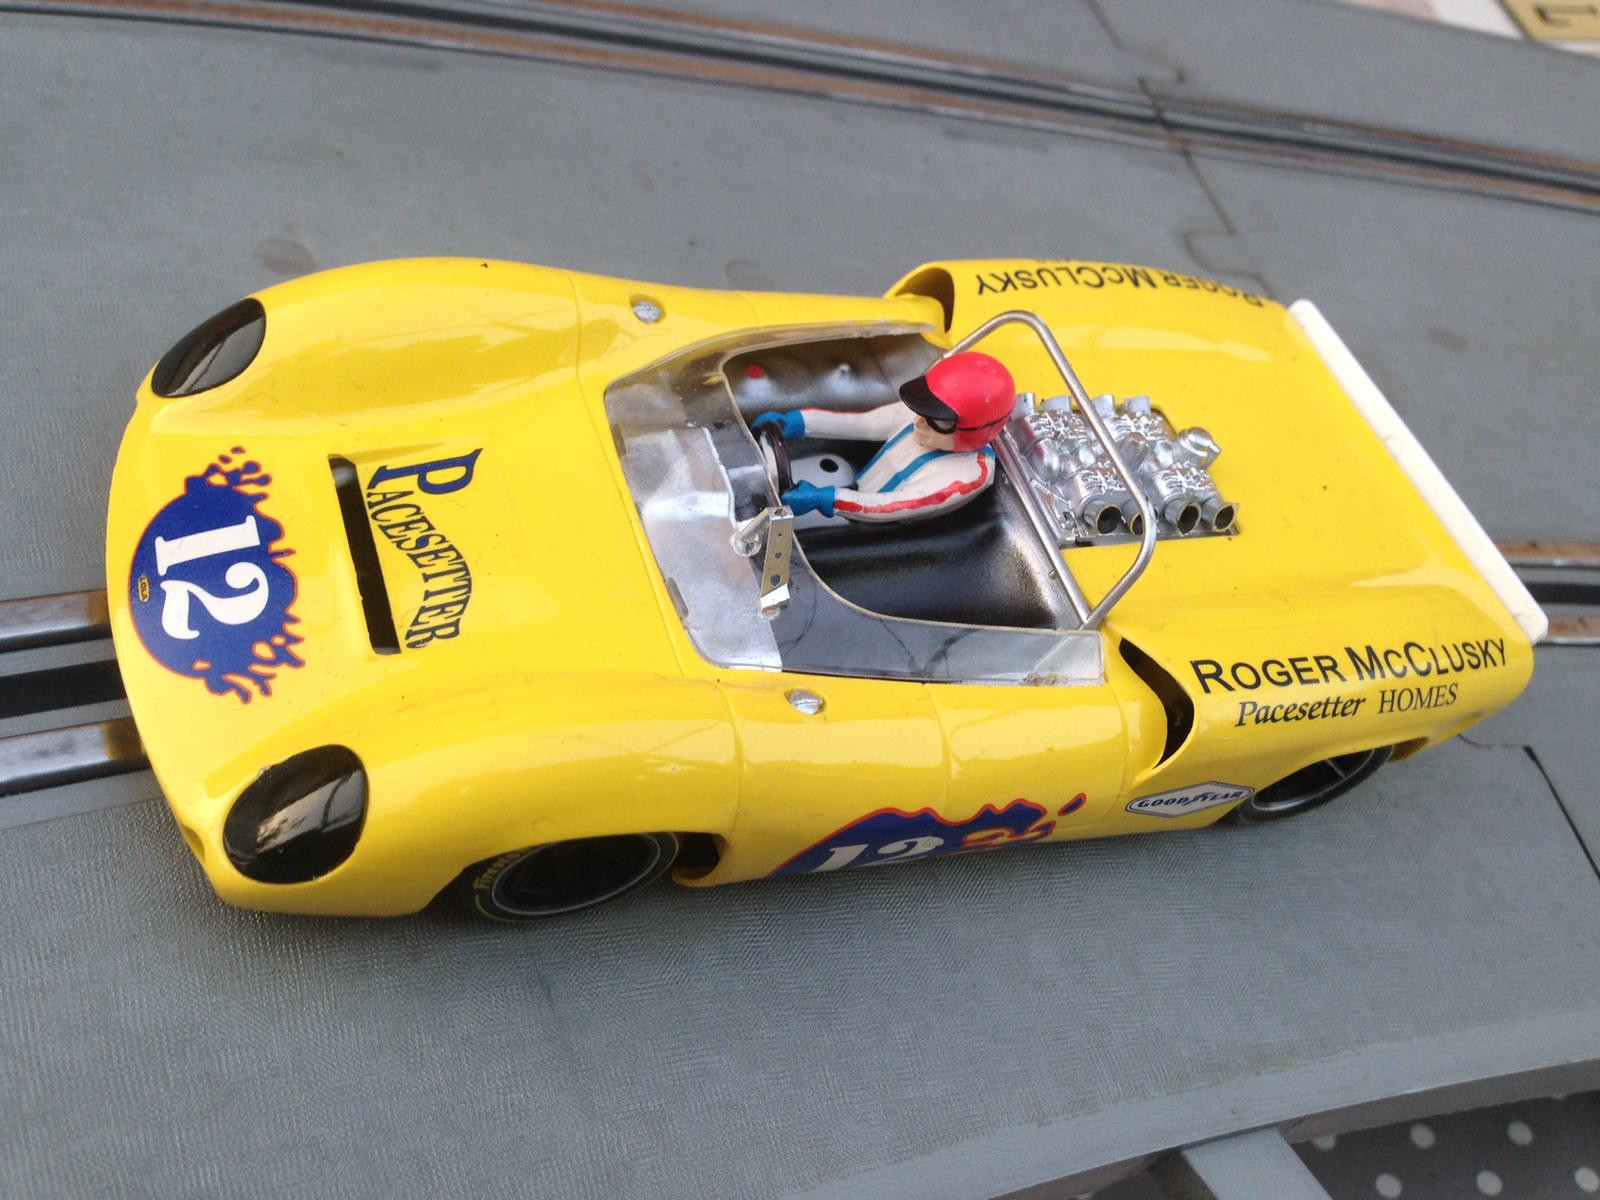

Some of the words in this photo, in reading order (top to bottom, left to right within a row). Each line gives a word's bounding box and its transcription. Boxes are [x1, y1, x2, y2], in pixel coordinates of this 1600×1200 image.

[155, 515, 269, 640] 12
[367, 448, 482, 648] PACESETTER
[1190, 655, 1346, 694] ROGER
[1234, 695, 1366, 727] Pacesetter
[1377, 683, 1459, 714] HOMES
